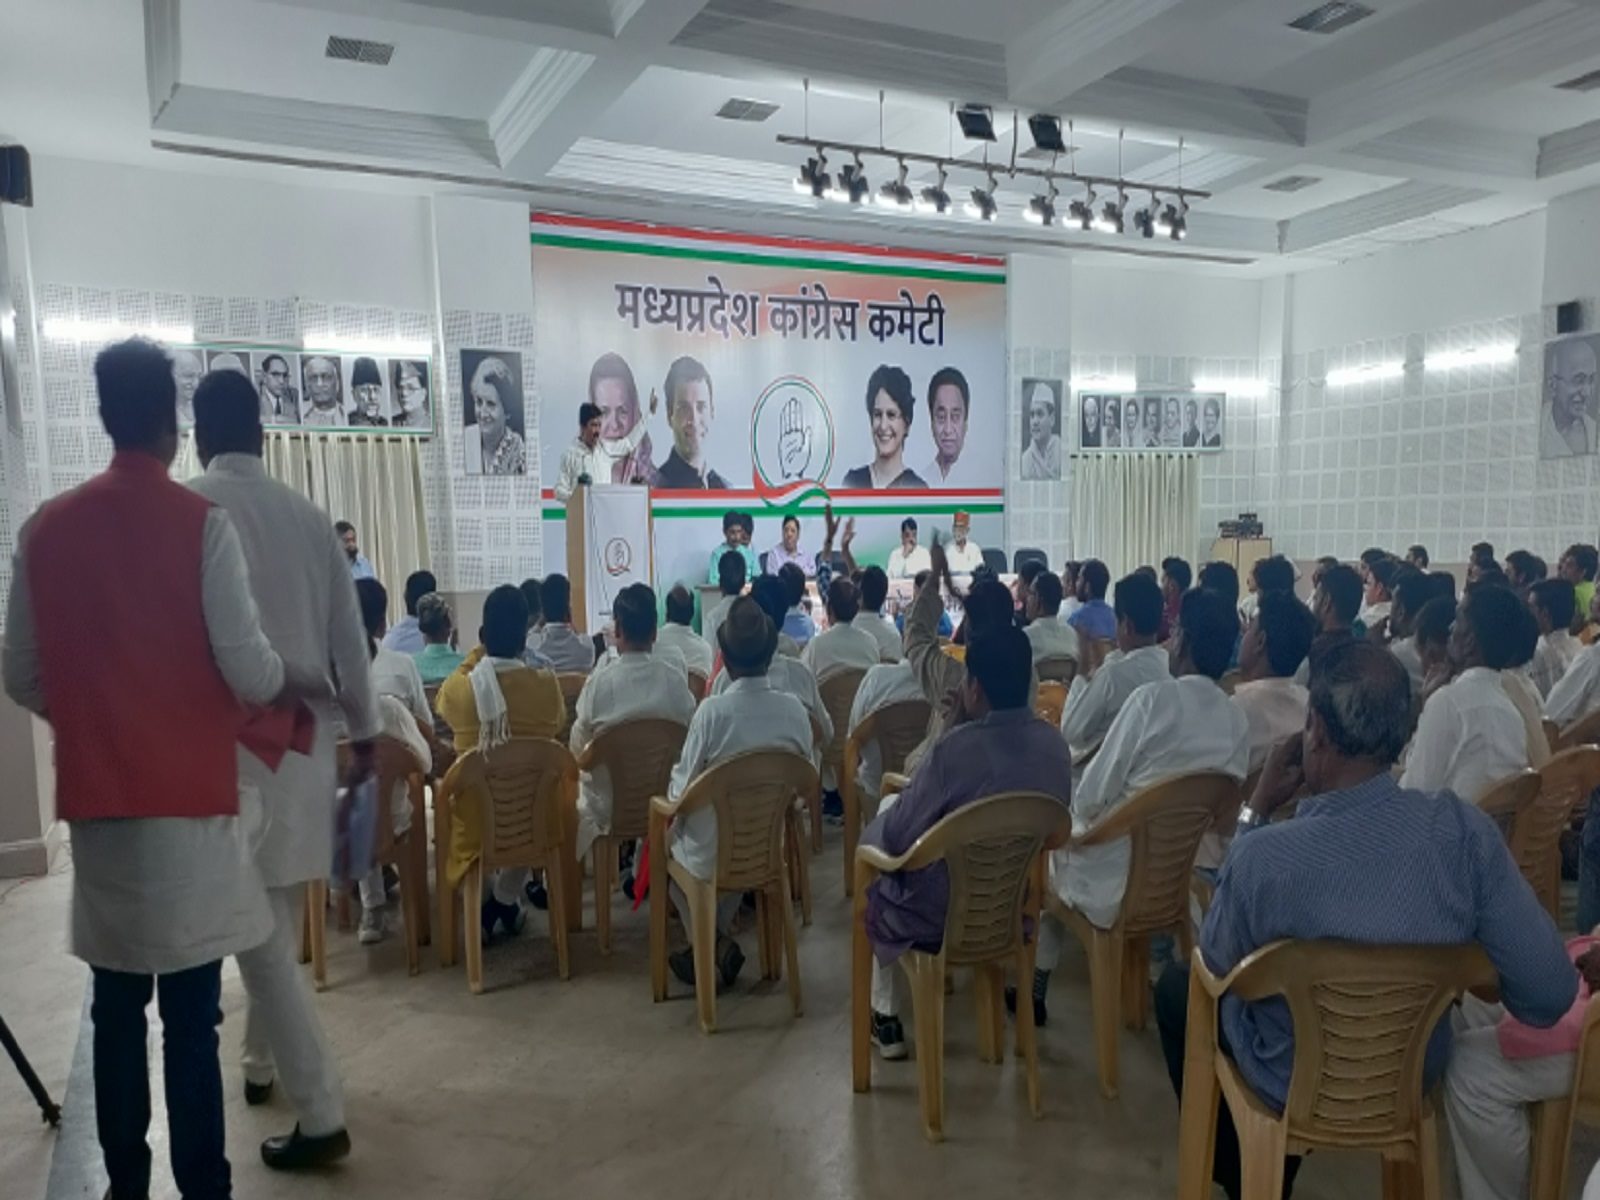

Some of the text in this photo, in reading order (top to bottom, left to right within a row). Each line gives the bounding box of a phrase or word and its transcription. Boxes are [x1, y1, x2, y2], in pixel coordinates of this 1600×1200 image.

[614, 276, 945, 346] मध्यप्रदेश कांग्रेस कमेटी
